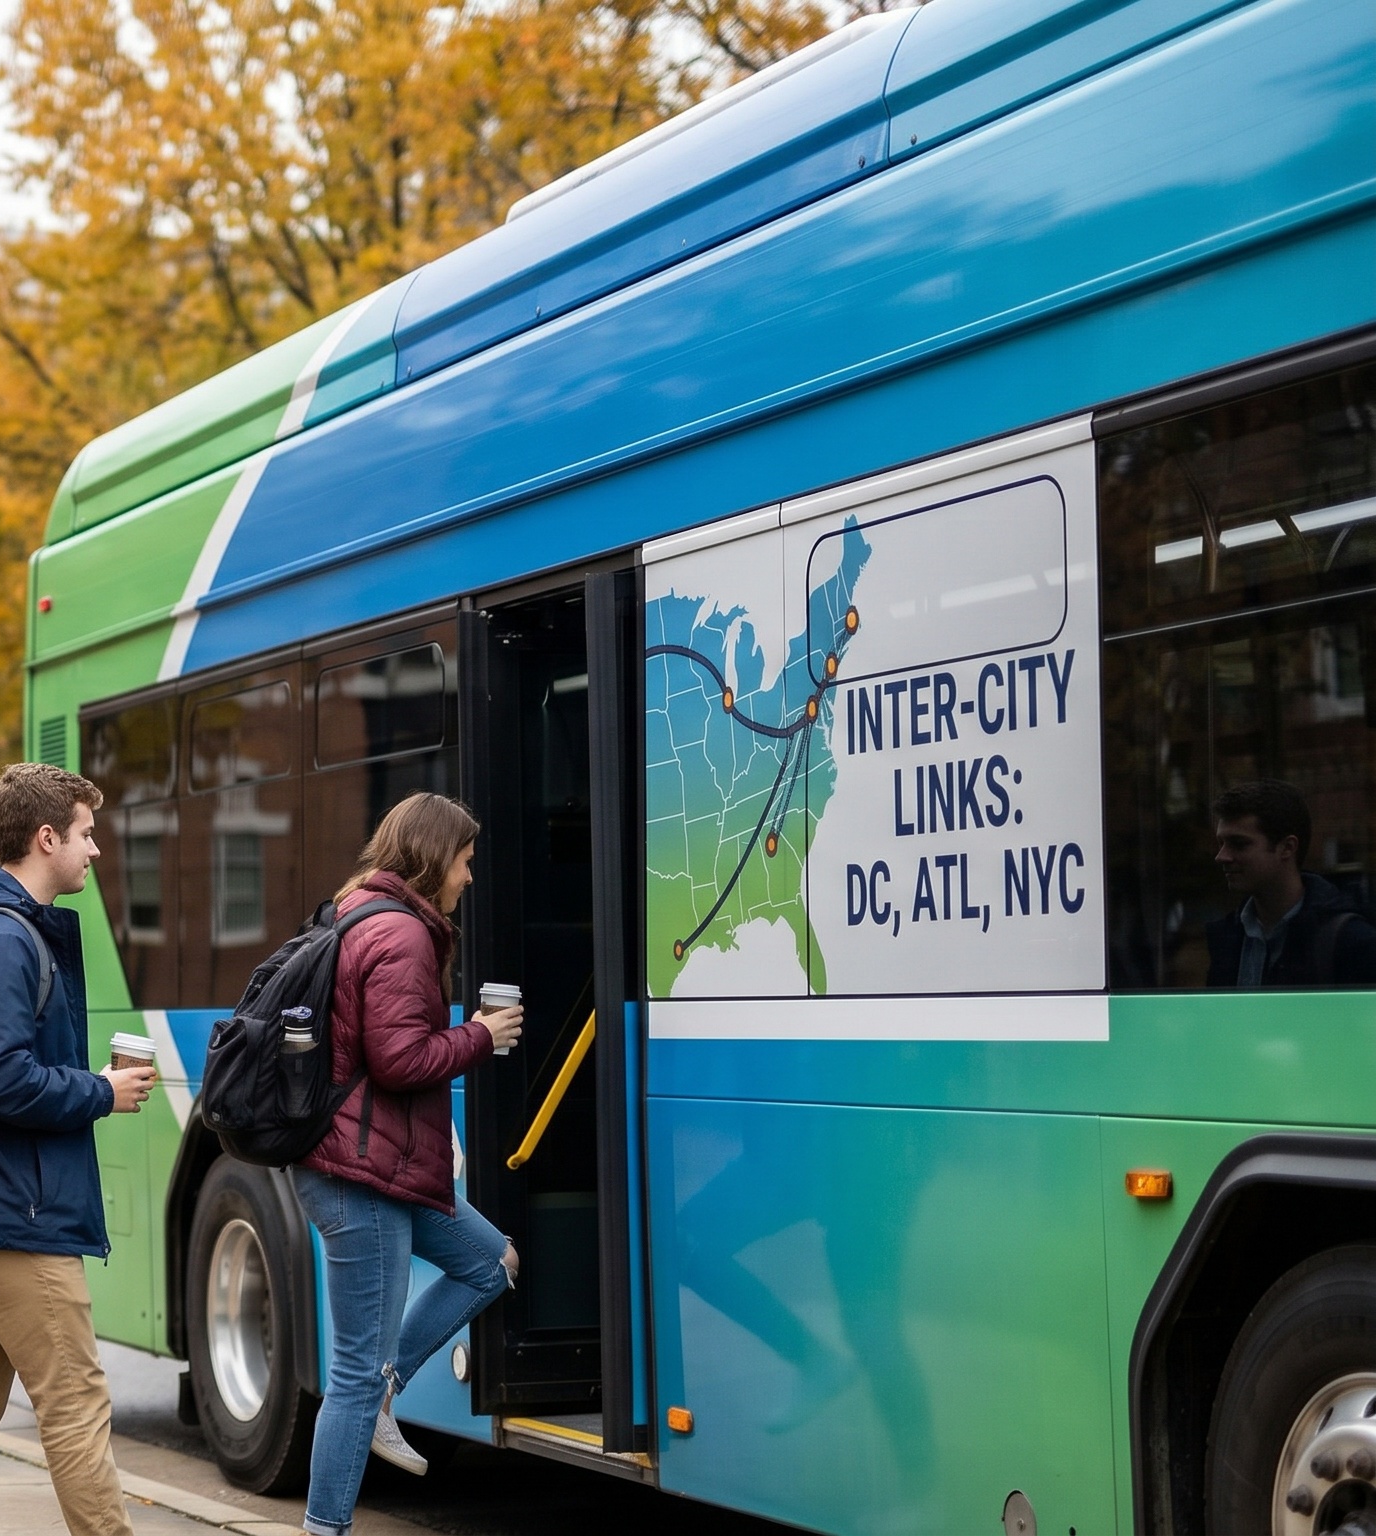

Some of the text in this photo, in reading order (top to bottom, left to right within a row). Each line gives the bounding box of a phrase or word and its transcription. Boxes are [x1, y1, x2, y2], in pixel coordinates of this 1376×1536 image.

[846, 648, 1076, 756] INTER-CITY
[894, 754, 1024, 837] LINKS:
[846, 842, 1086, 938] DC, ATL, NYC
